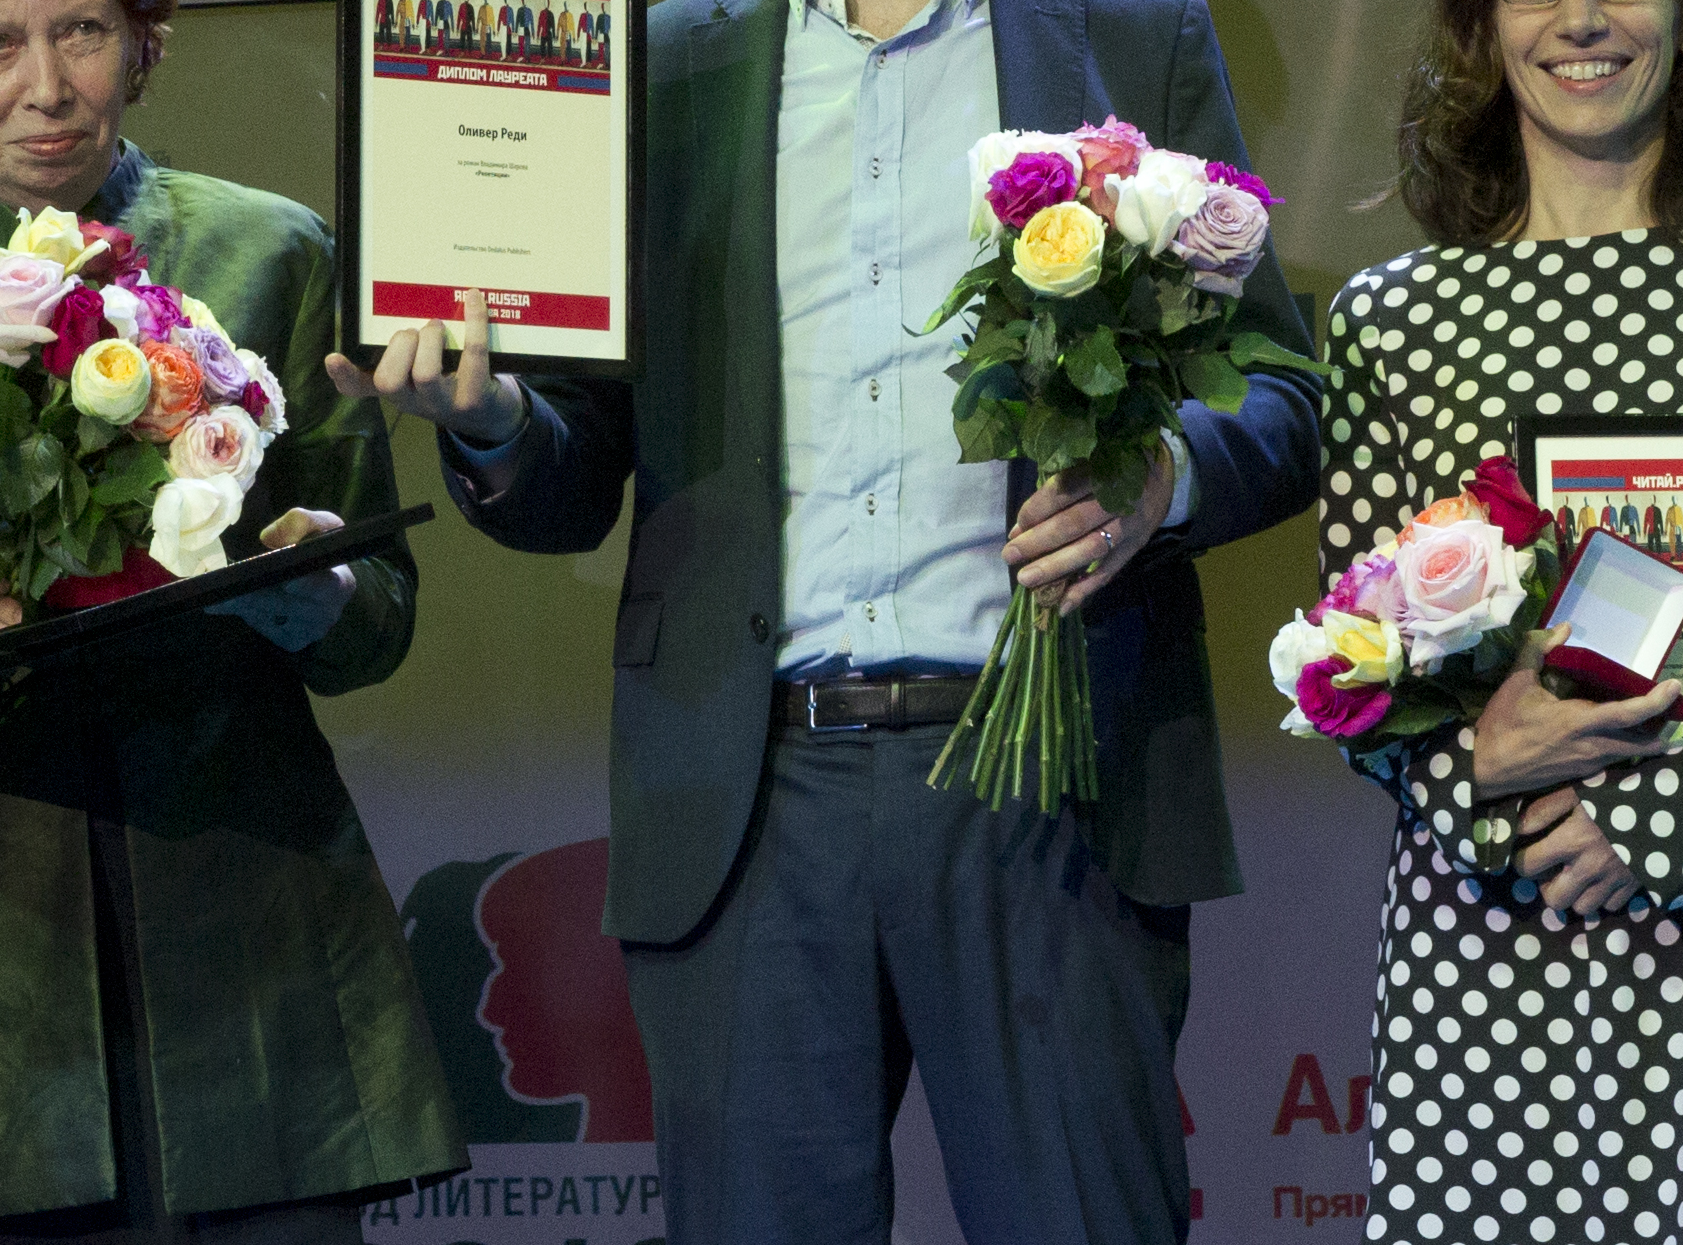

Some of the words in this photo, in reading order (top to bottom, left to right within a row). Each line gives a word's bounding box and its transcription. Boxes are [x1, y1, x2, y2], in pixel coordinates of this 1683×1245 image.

[437, 65, 487, 81] ДИПЛОМ
[489, 69, 548, 86] ЛАУРЕАТА
[458, 124, 498, 141] Оливер
[501, 127, 527, 142] Реди
[500, 308, 521, 320] 2018
[413, 1174, 662, 1219] ЛИТЕРАТУР
